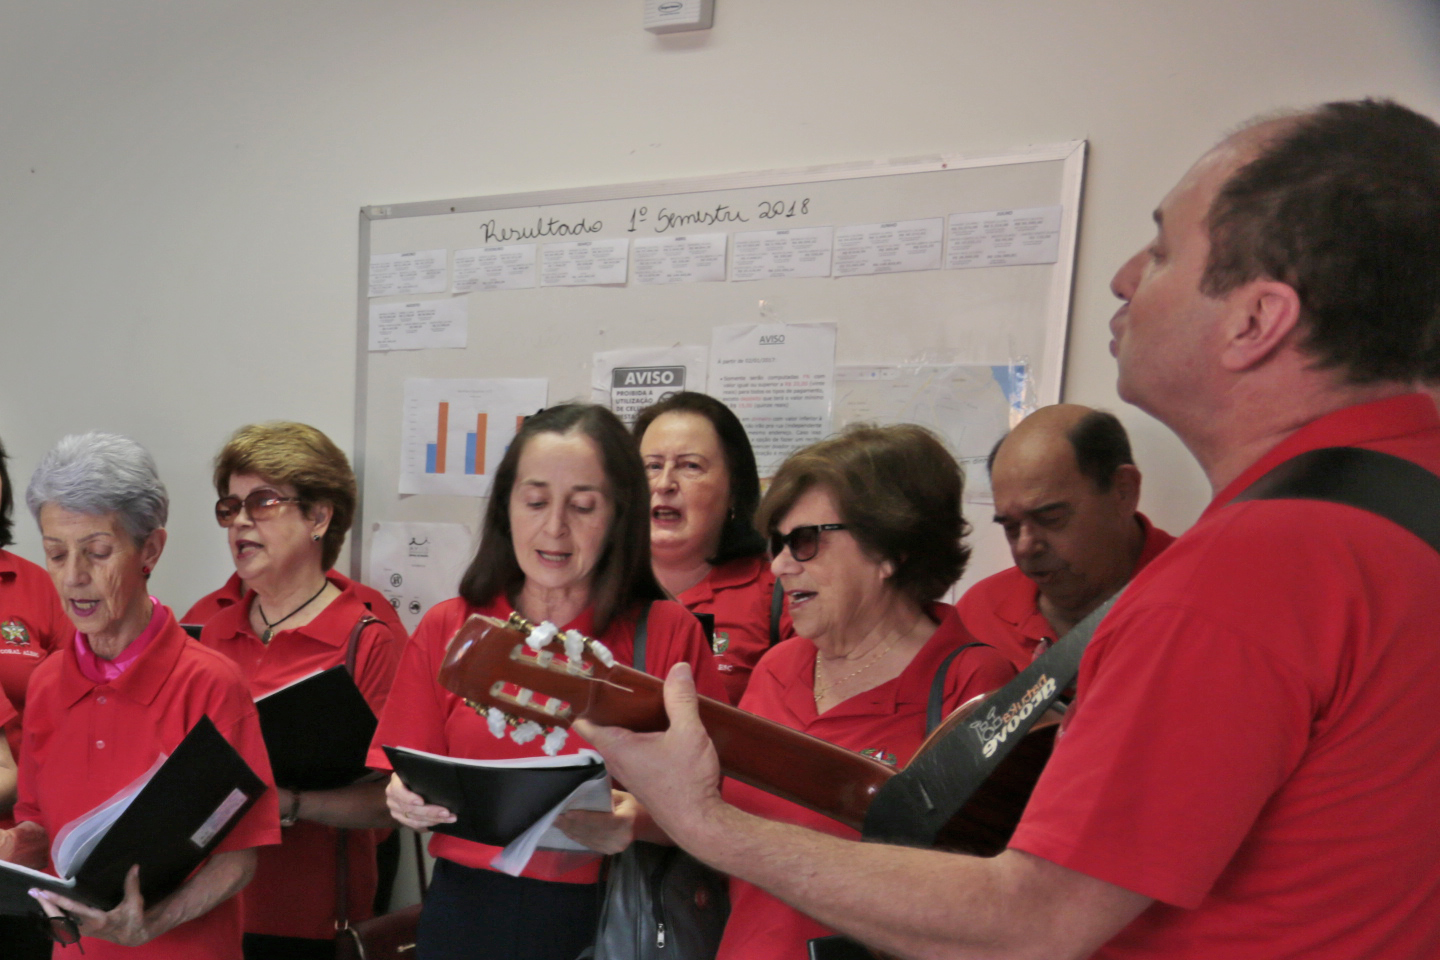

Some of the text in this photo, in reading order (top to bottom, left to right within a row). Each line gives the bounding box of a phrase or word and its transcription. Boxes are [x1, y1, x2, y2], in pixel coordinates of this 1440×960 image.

[480, 217, 603, 243] Resultado
[758, 198, 810, 220] 2018
[759, 334, 786, 343] AVISO
[624, 371, 674, 385] AVISO
[615, 397, 653, 405] UTILIZAÇÃO
